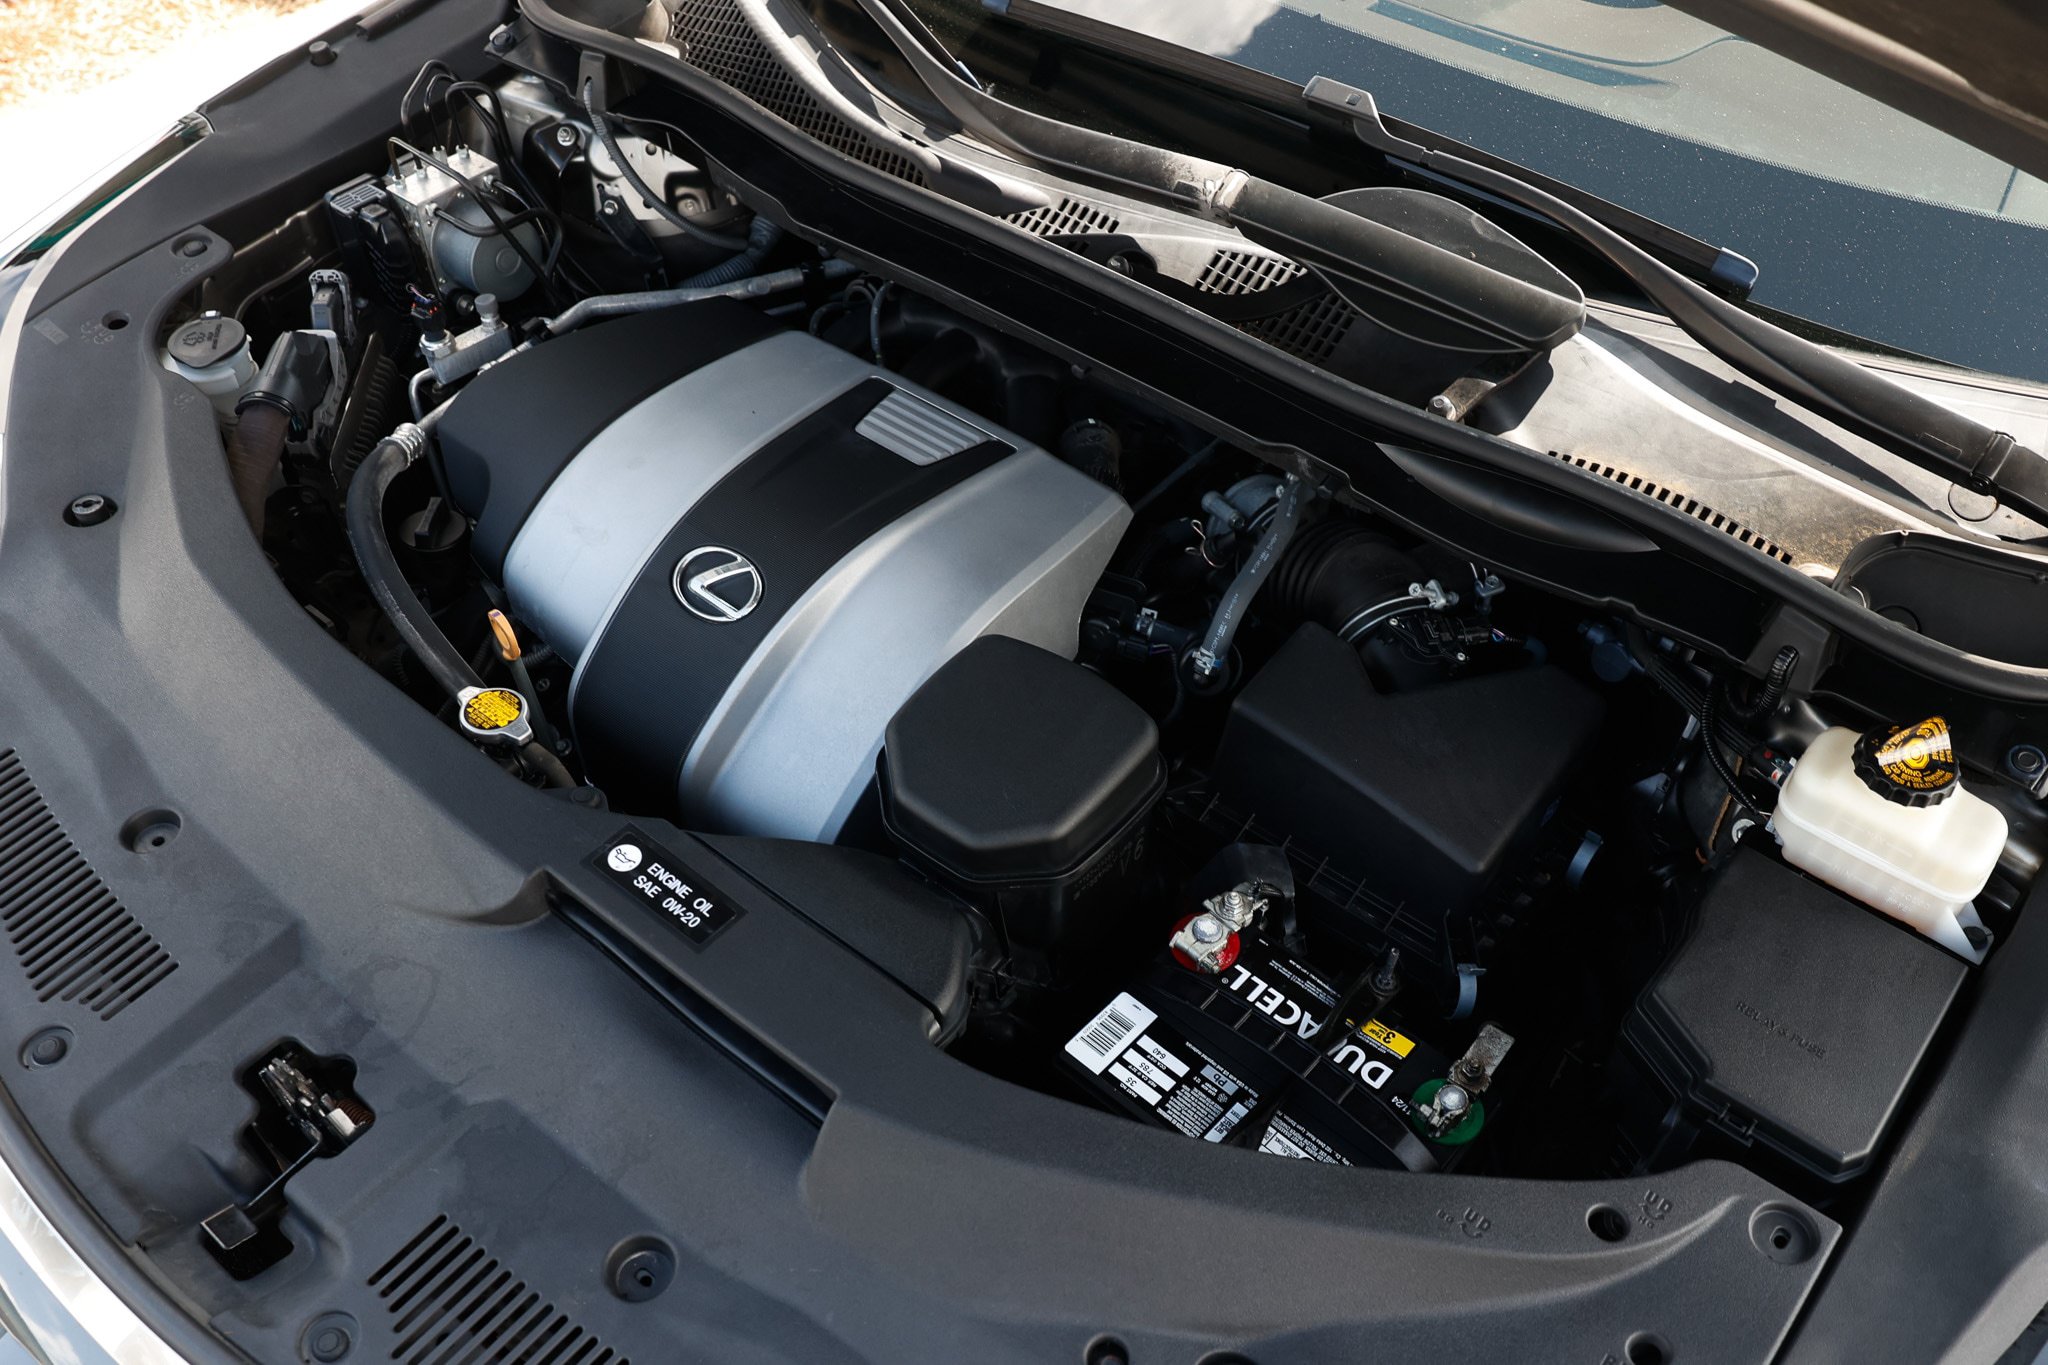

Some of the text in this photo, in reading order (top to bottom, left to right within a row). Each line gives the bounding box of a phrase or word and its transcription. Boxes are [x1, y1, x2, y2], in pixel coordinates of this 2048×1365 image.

[646, 863, 714, 918] ENGINE OIL
[634, 876, 701, 928] SAE 0W-20
[1227, 964, 1395, 1091] DUACELL
[1735, 1000, 1777, 1033] RELAY
[1790, 1032, 1827, 1060] FUSE
[1367, 1028, 1395, 1043] 3 Year
[1152, 1047, 1167, 1060] 640
[1139, 1062, 1154, 1076] 785
[1125, 1077, 1137, 1087] 35
[1214, 1074, 1227, 1087] Pb
[1126, 1087, 1137, 1098] PART
